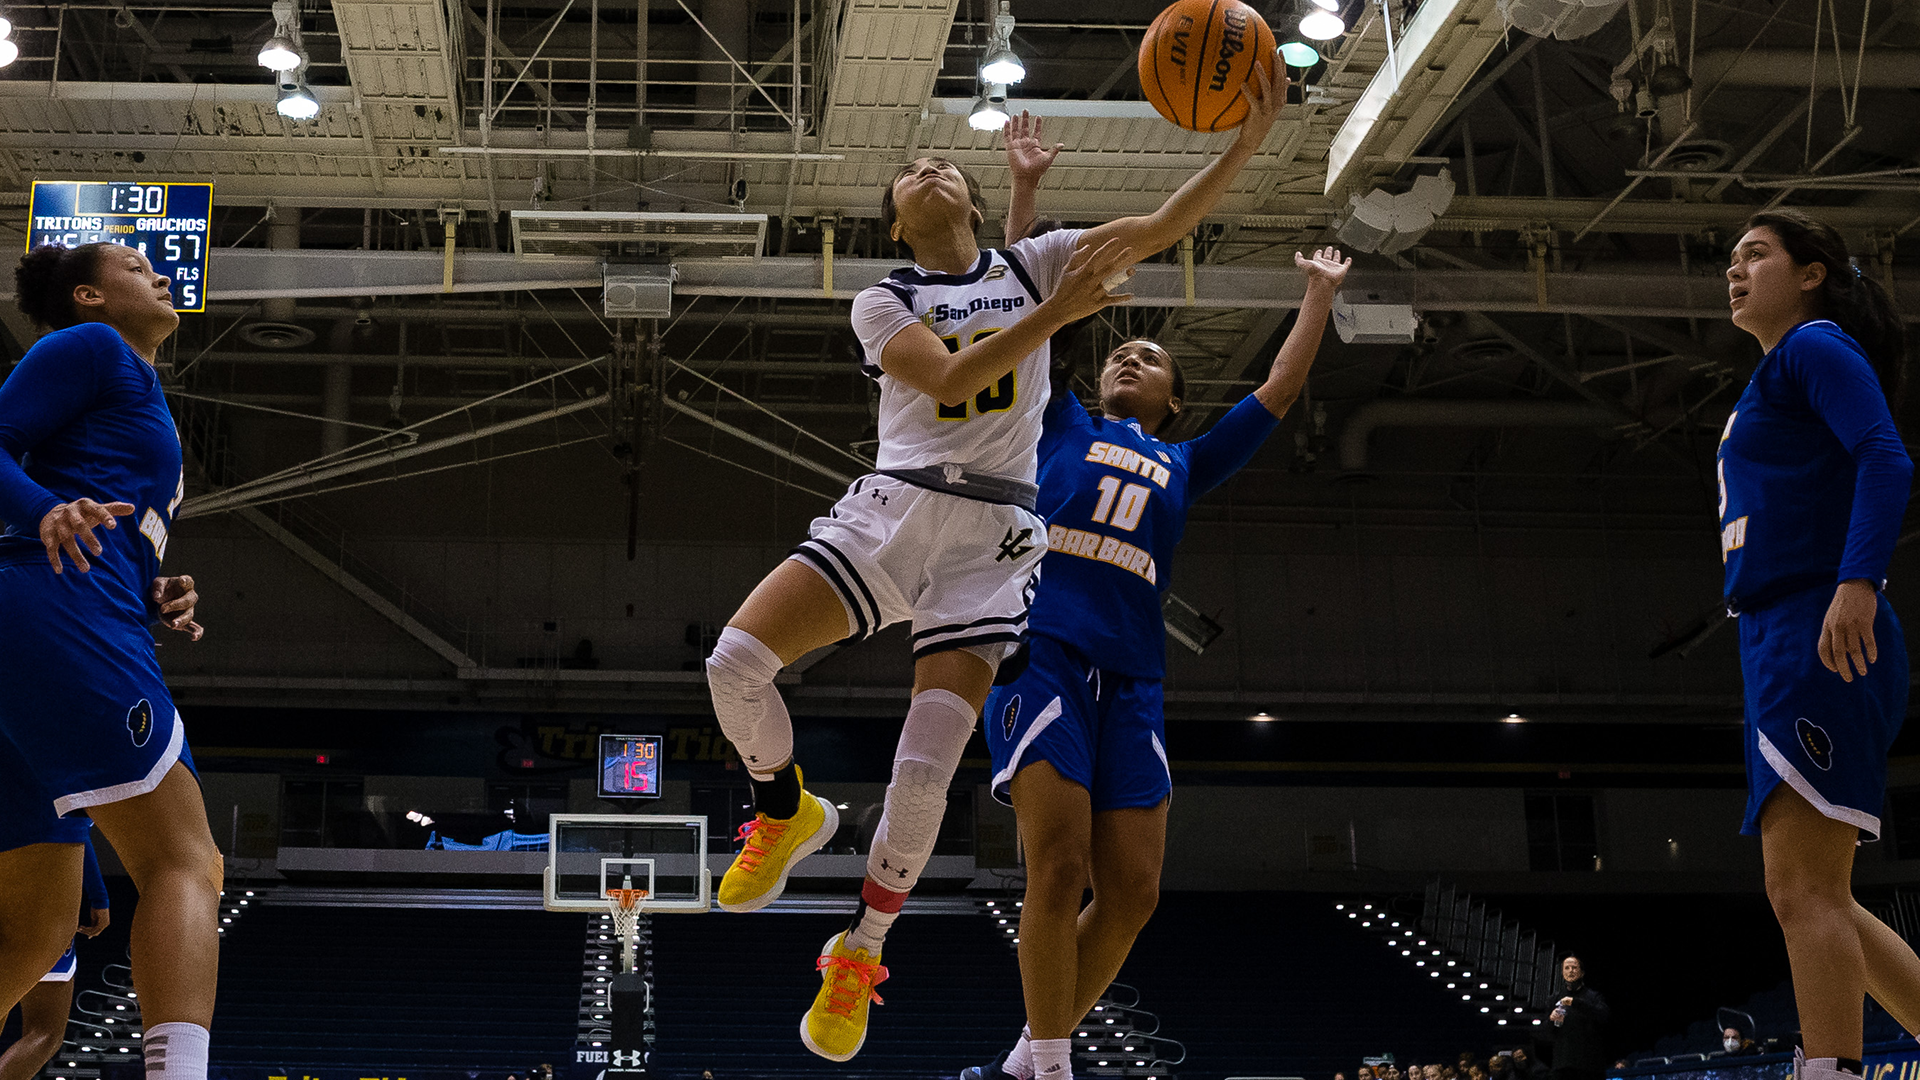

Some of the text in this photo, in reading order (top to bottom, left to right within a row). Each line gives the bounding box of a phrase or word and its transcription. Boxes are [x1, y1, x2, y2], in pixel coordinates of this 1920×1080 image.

[1208, 9, 1246, 92] Wilson
[110, 186, 163, 213] 1:30
[35, 216, 102, 230] TRITONS
[103, 225, 135, 234] PERIOD
[136, 217, 207, 232] GAUCHOS
[164, 234, 200, 261] 57
[176, 267, 199, 281] FLS
[183, 285, 197, 306] 5
[1085, 441, 1171, 489] SANTA
[1091, 475, 1151, 532] 10
[624, 761, 648, 791] 15
